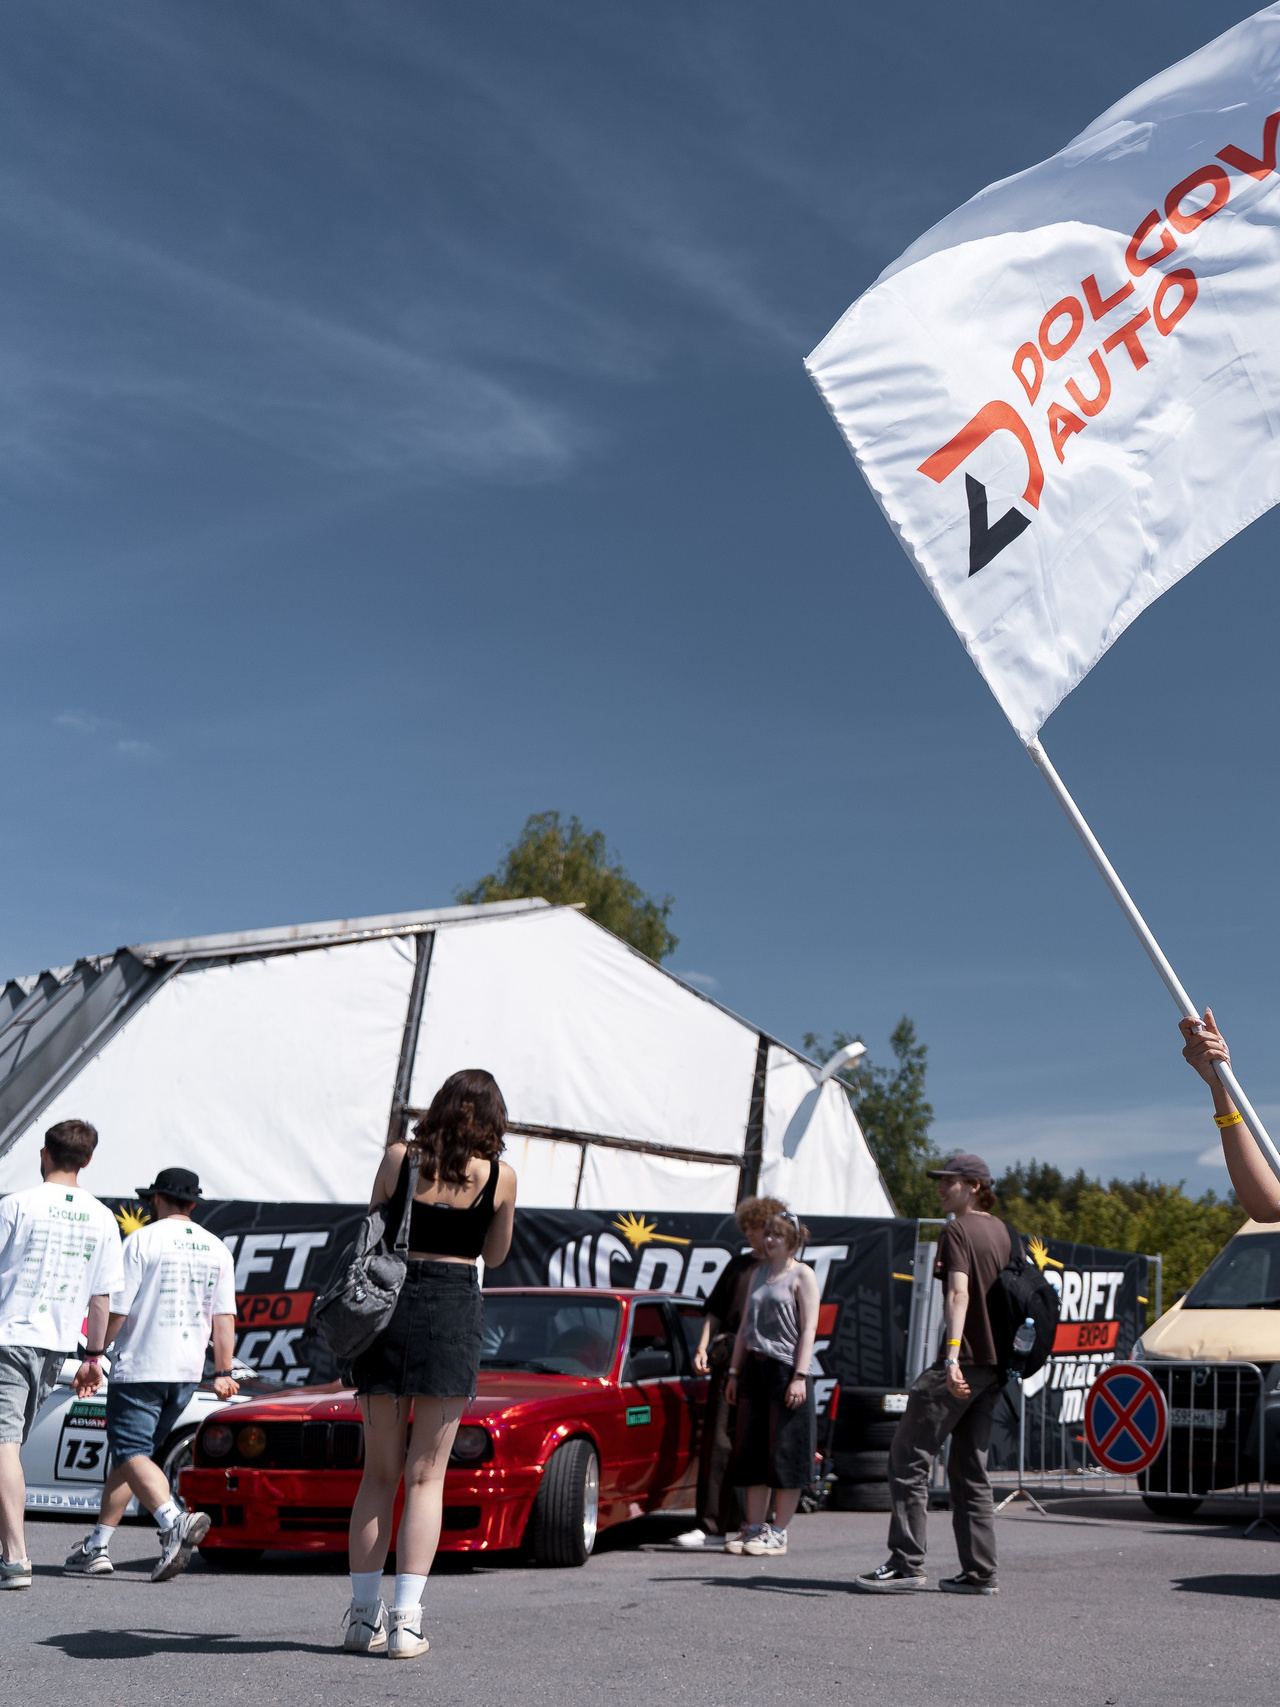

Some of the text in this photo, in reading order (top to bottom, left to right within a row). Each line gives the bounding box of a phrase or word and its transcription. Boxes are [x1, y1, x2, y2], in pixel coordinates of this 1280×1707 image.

[1046, 268, 1198, 465] AUTO
[237, 1296, 293, 1323] XPO
[1077, 1324, 1109, 1347] EXPO
[70, 1417, 106, 1429] ADVAN
[64, 1438, 105, 1470] 13
